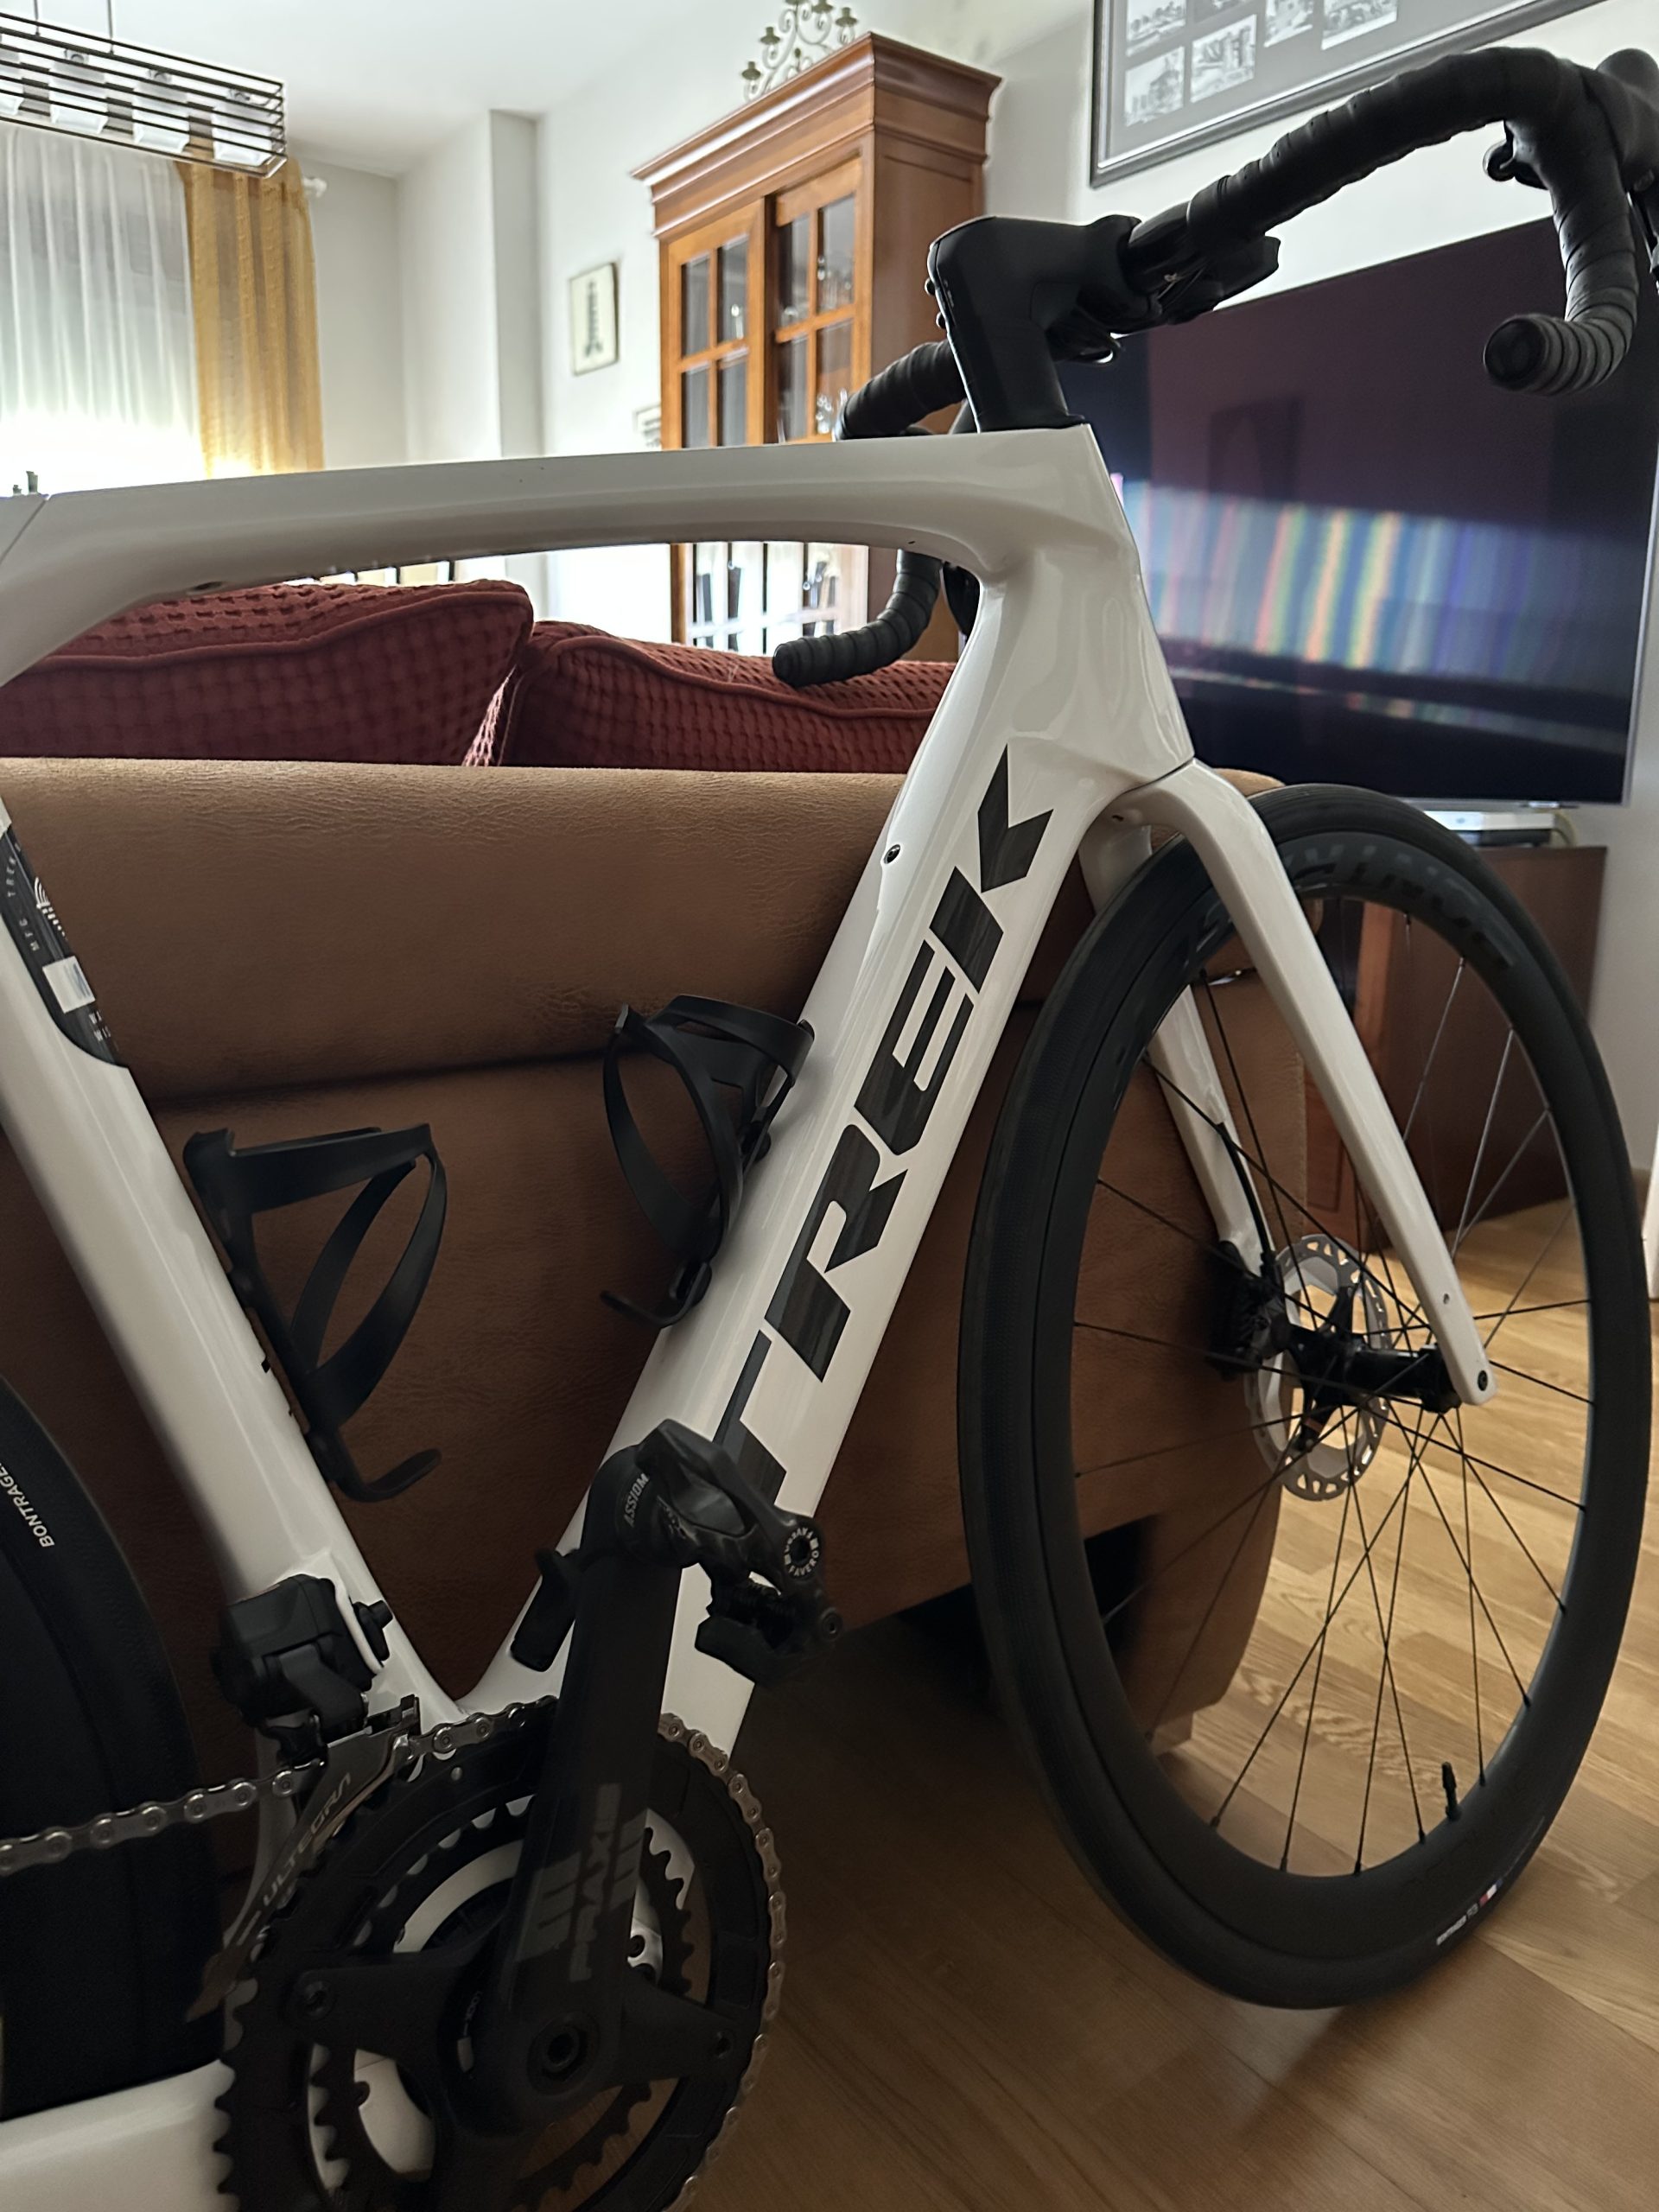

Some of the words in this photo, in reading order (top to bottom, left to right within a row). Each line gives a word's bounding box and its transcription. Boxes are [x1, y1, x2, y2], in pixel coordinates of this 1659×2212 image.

[713, 744, 1054, 1505] TREK
[0, 1463, 55, 1548] BONTRAGE
[624, 1473, 650, 1528] ASSIOM
[787, 1550, 820, 1577] FAVERO
[263, 1772, 351, 1907] ULTEGRA
